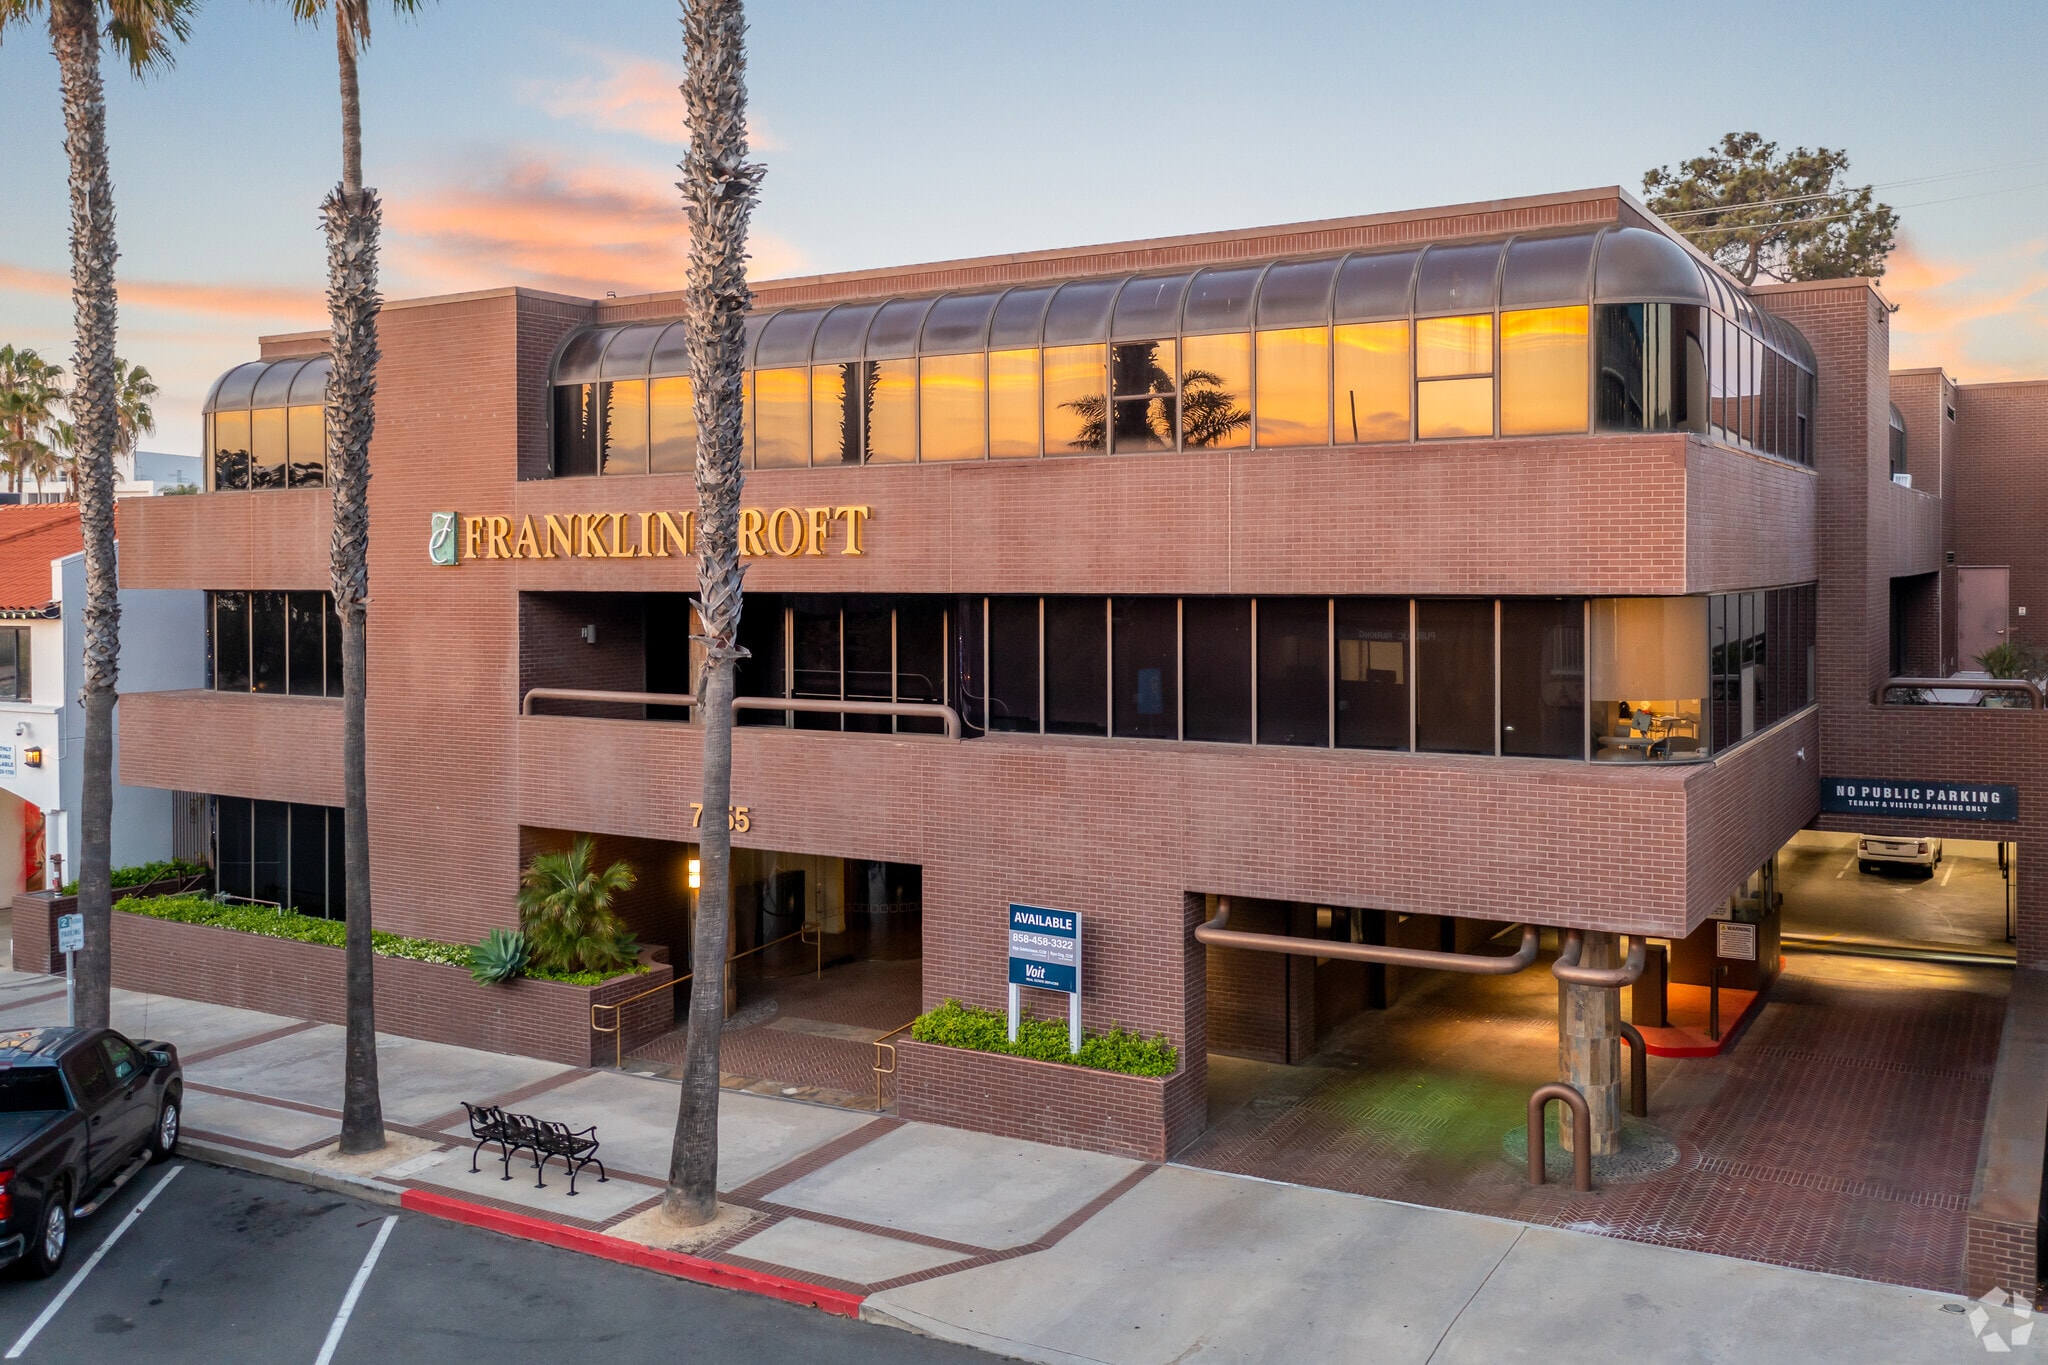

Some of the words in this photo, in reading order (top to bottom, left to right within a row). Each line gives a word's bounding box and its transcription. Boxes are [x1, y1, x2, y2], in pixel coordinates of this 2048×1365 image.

[463, 511, 694, 559] FRANKLIN
[738, 506, 871, 556] ROFT
[1836, 785, 1856, 797] NO
[1862, 786, 1920, 800] PUBLIC
[1926, 789, 2000, 803] PARKING
[1890, 801, 1924, 809] VISITOR
[1926, 803, 1963, 811] PARKING
[61, 918, 67, 927] 2
[1014, 912, 1073, 930] AVAILABLE
[1012, 933, 1073, 950] 858-458-3322
[1026, 964, 1045, 979] Voit
